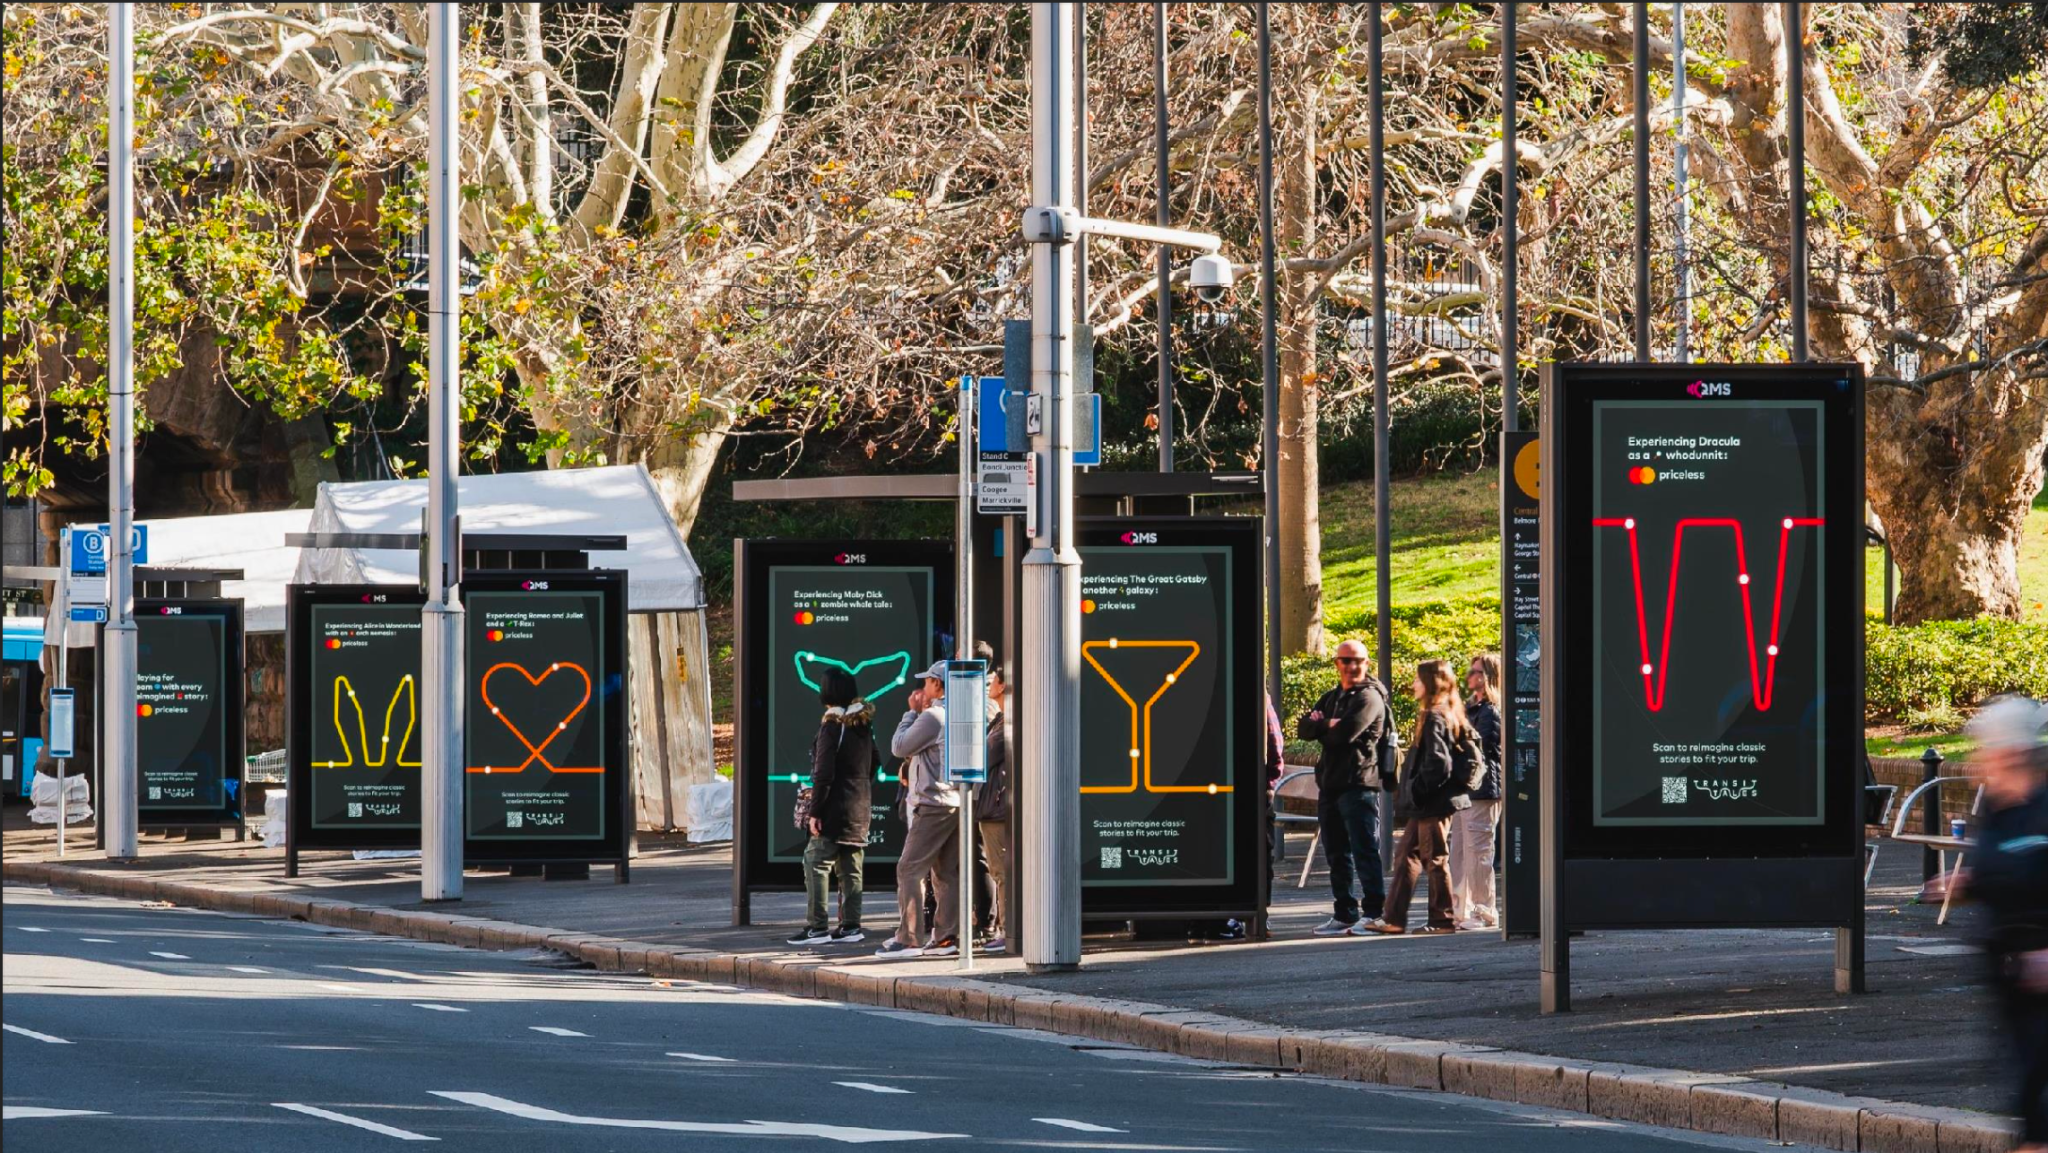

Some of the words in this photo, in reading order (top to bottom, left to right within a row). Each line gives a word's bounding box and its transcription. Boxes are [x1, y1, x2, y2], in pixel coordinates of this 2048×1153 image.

[1628, 436, 1696, 449] Experiencing
[1699, 436, 1740, 447] Dracula
[982, 452, 1002, 460] Stand
[1003, 452, 1009, 460] C
[1628, 451, 1641, 460] as
[1642, 452, 1650, 460] a
[1665, 449, 1728, 460] whodunnit:
[1659, 469, 1705, 481] priceless
[982, 485, 1007, 494] Coogee
[90, 537, 98, 549] B
[1080, 575, 1129, 584] xperiencing
[1130, 575, 1146, 583] The
[1148, 575, 1173, 583] Great
[1175, 575, 1207, 584] Gatsby
[794, 590, 842, 599] Experiencing
[844, 590, 865, 599] Moby
[866, 590, 883, 598] Dick
[1083, 586, 1117, 594] another
[820, 600, 848, 608] zombie
[1099, 601, 1136, 611] priceless
[96, 611, 104, 620] D
[486, 612, 528, 620] Experiencing
[816, 614, 849, 623] priceless
[325, 622, 363, 630] Experiencing
[505, 631, 533, 639] priceless
[342, 640, 368, 648] priceless
[162, 673, 174, 681] for
[181, 684, 202, 692] every
[154, 707, 188, 715] priceless
[1653, 743, 1675, 752] Scan
[1677, 743, 1688, 752] to
[1689, 743, 1734, 753] reimagine
[1736, 743, 1766, 752] classic
[1660, 755, 1691, 763] stories
[1692, 755, 1703, 763] to
[1705, 754, 1716, 763] fit
[1717, 756, 1737, 765] your
[1739, 755, 1758, 765] trip.
[1693, 780, 1757, 788] TRANSIT
[1093, 820, 1112, 828] Scan
[1113, 820, 1122, 828] to
[1123, 820, 1160, 829] reimagine
[1161, 820, 1185, 828] classic
[1099, 829, 1125, 837] stories
[1126, 829, 1134, 837] to
[1135, 829, 1145, 837] fit
[1146, 829, 1163, 838] your
[1127, 849, 1178, 857] TRANSIT
